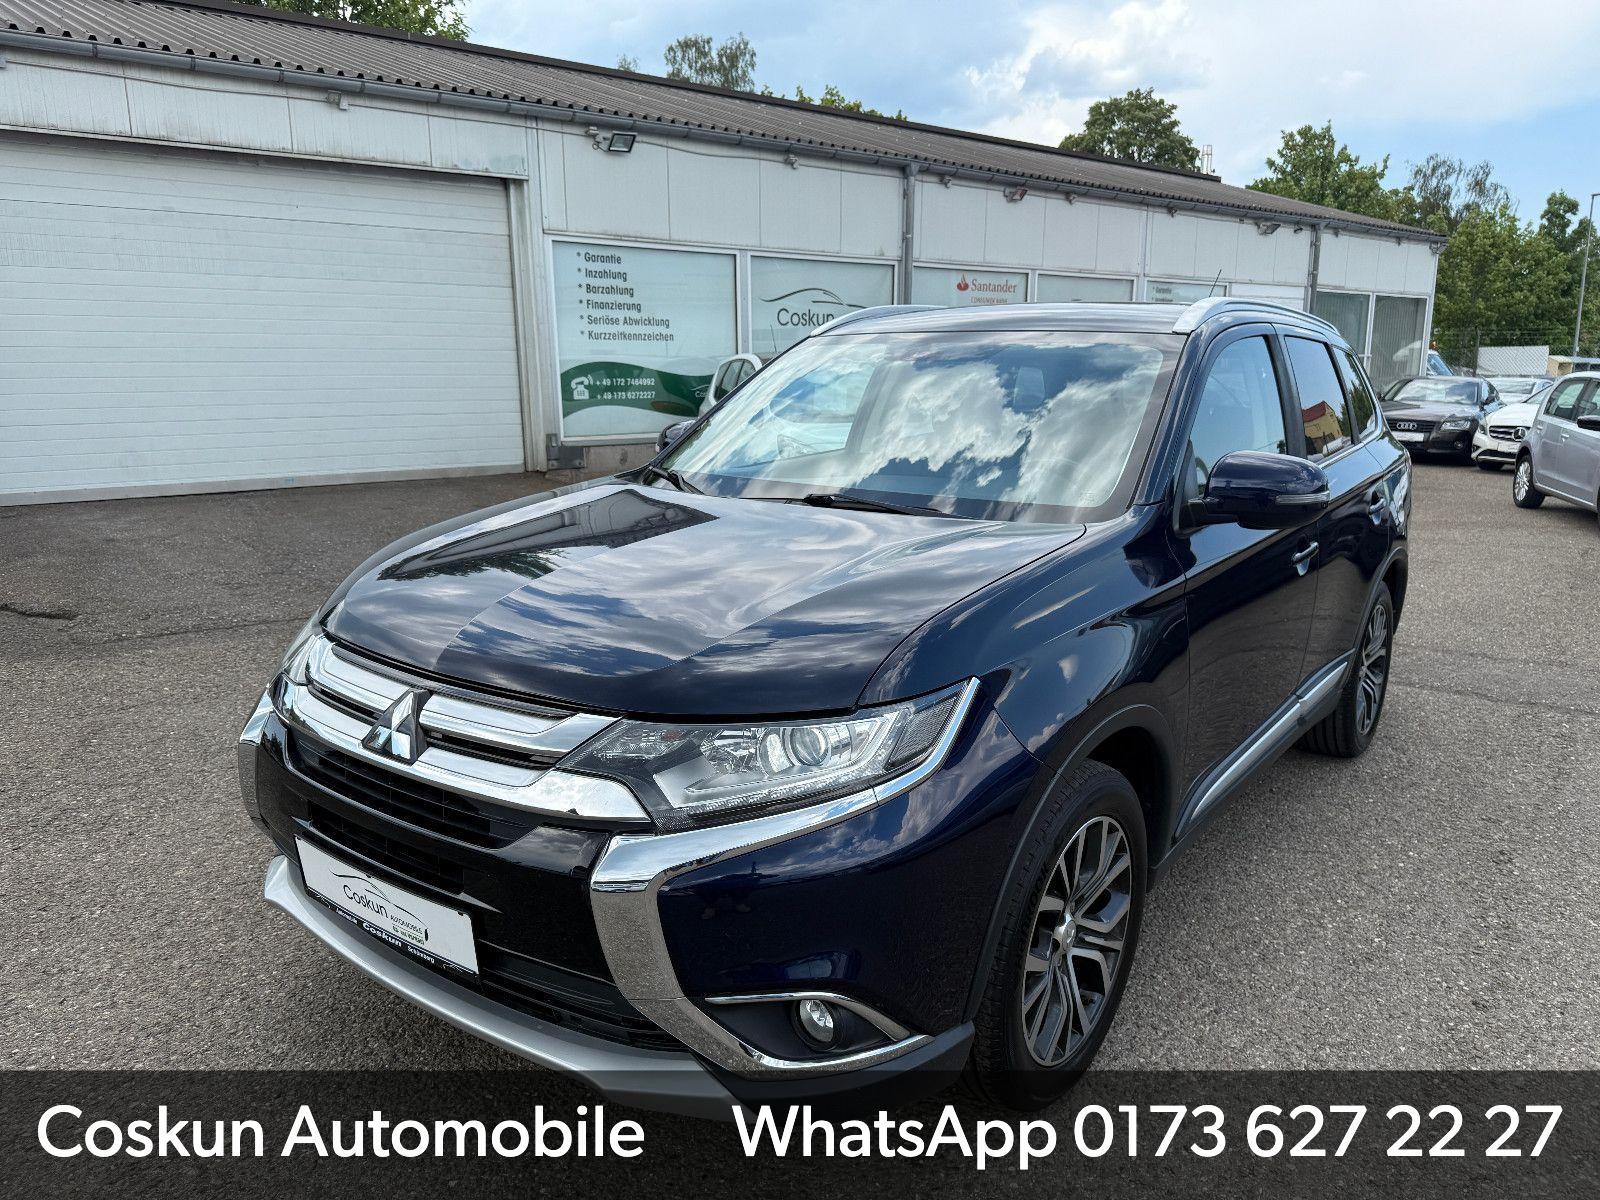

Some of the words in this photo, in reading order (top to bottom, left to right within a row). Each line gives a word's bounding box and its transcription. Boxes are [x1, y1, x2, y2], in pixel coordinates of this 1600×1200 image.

[584, 252, 622, 264] Garantie
[585, 268, 627, 282] Inzahlung
[586, 284, 634, 297] Barzahlung
[971, 279, 1017, 293] Santander
[586, 300, 642, 313] Finanzierung
[587, 314, 620, 326] Seriöse
[623, 316, 670, 329] Abwicklung
[588, 330, 675, 341] Kurzzeitkennzeichen
[613, 378, 625, 386] 172
[343, 884, 389, 919] Coskun
[362, 922, 402, 947] Coskun
